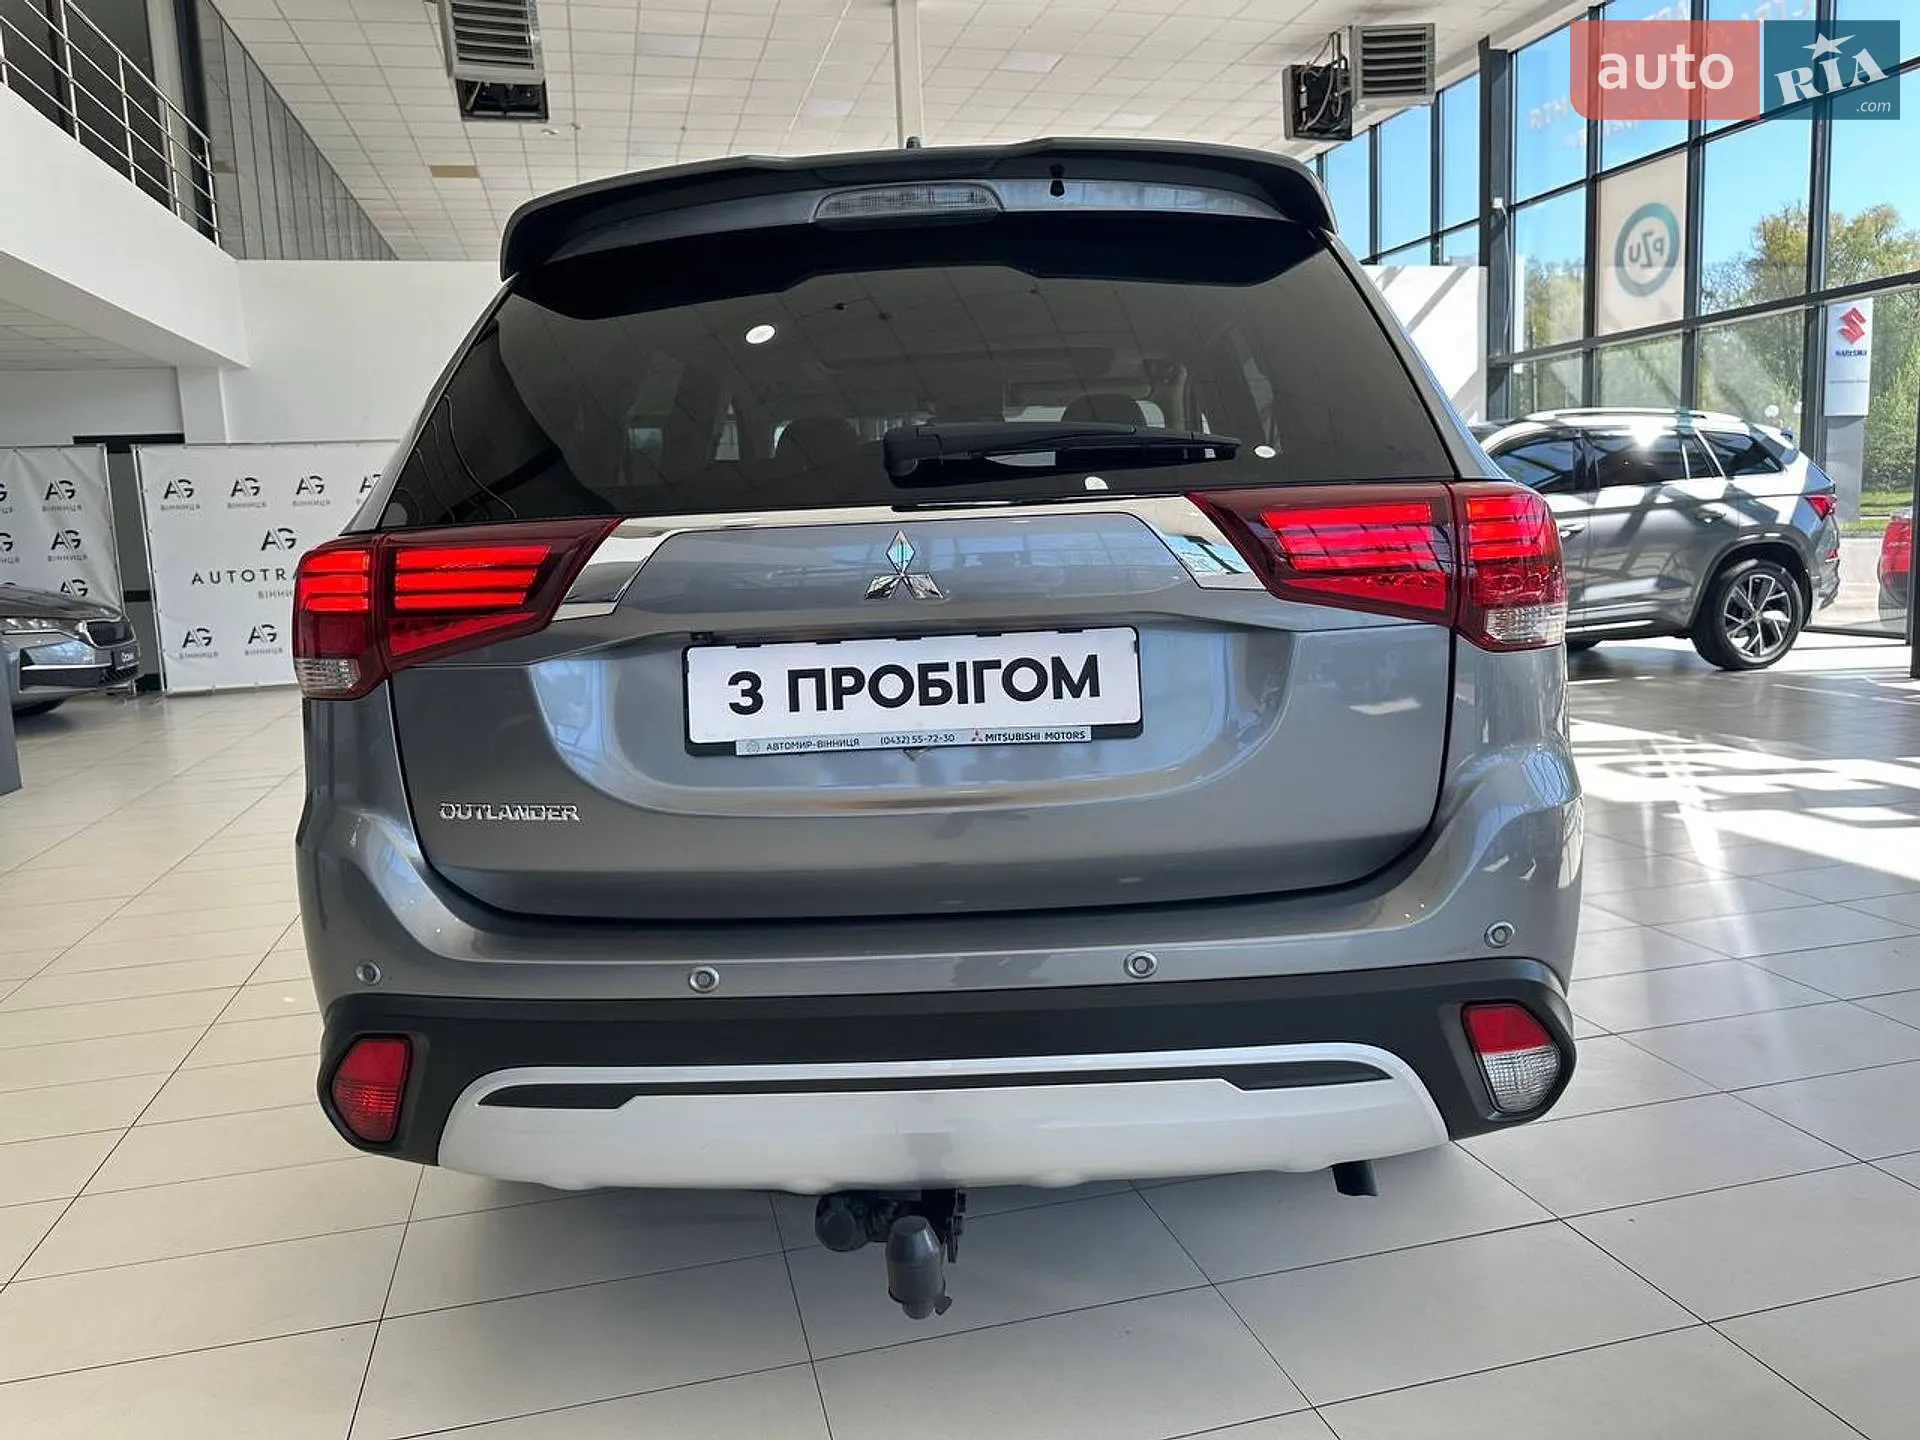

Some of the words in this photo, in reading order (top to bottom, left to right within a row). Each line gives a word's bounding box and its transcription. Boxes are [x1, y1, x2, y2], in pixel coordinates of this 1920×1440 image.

[192, 568, 297, 585] AUTOTR
[787, 654, 1101, 713] ПРОБІГОМ
[766, 738, 860, 752] АВТОМИР-ВІННИЦЯ
[985, 733, 1041, 743] MITSUBISHI
[1044, 731, 1087, 741] MOTORS
[439, 803, 581, 821] OUTLANDER
